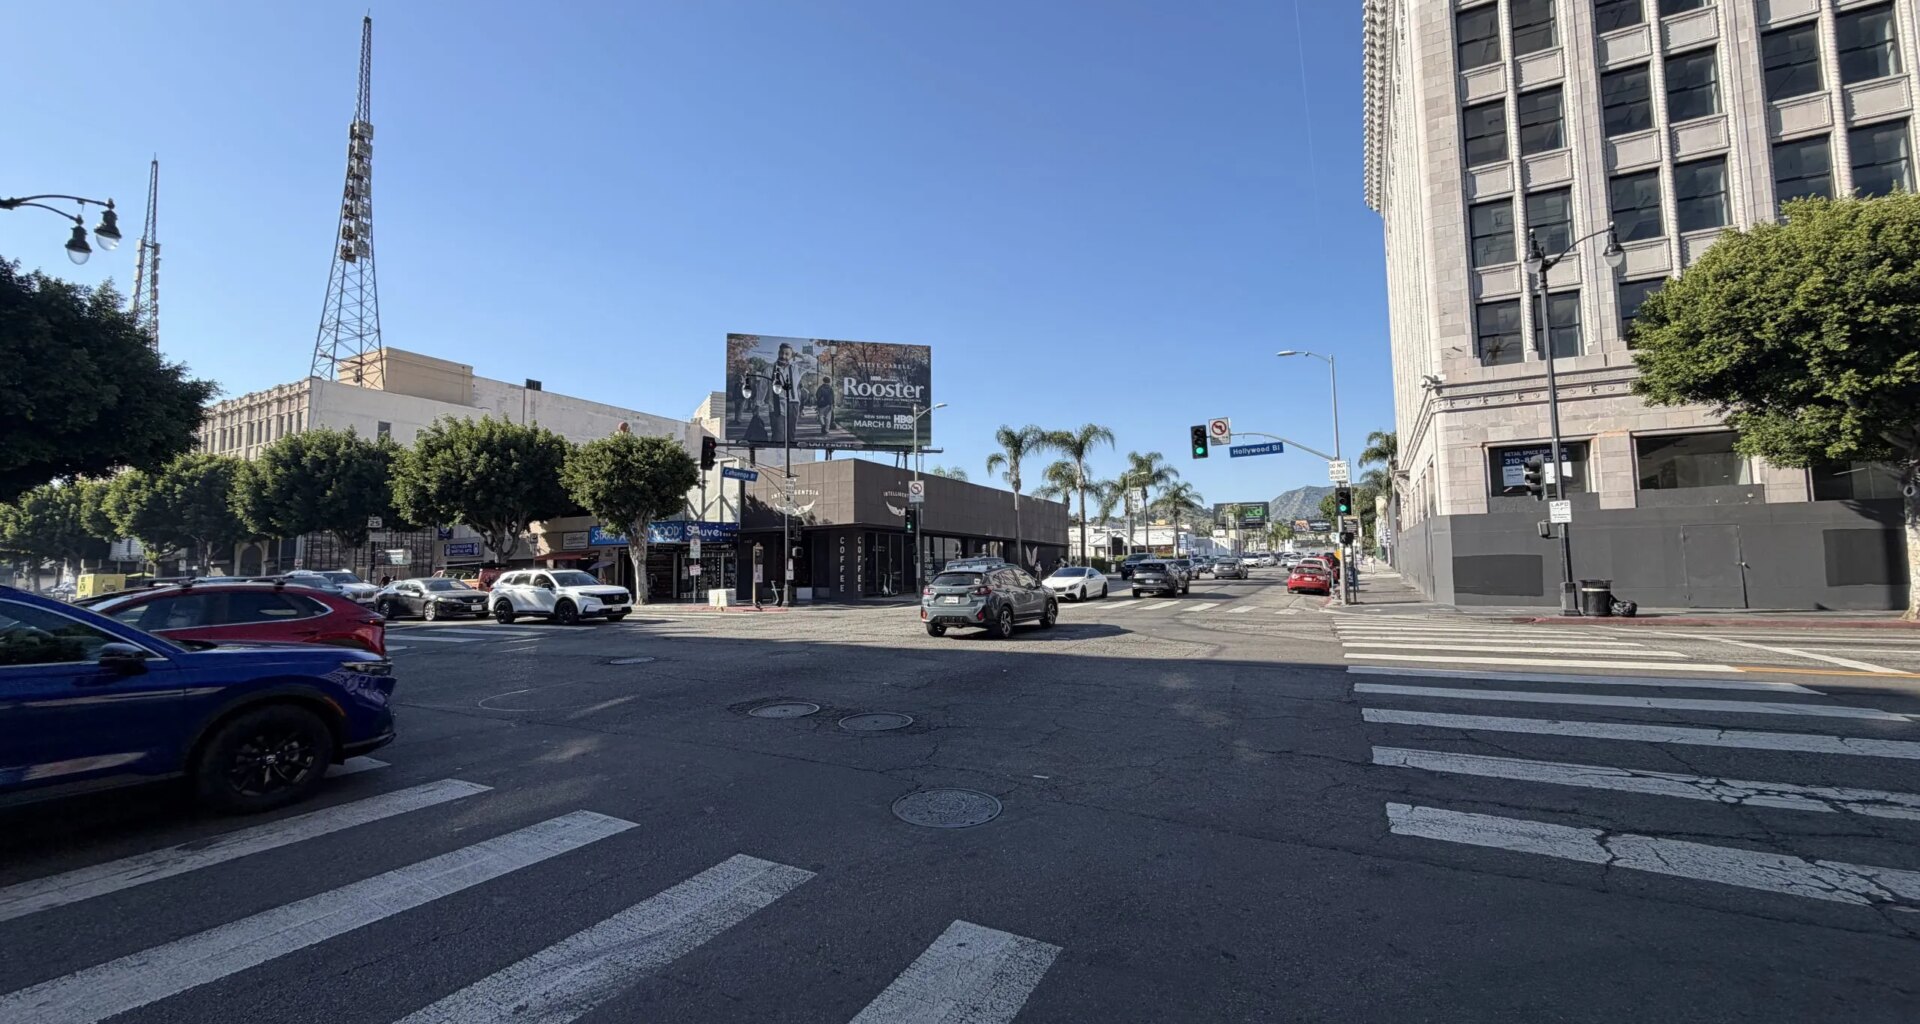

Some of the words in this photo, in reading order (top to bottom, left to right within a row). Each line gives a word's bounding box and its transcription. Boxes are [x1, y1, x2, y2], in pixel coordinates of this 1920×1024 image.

[843, 377, 925, 398] Rooster
[894, 415, 913, 424] HBO
[886, 421, 892, 429] 8
[1233, 446, 1270, 455] Hollywood
[724, 469, 749, 479] Cahuenga
[771, 489, 819, 499] INTEGENTSIA
